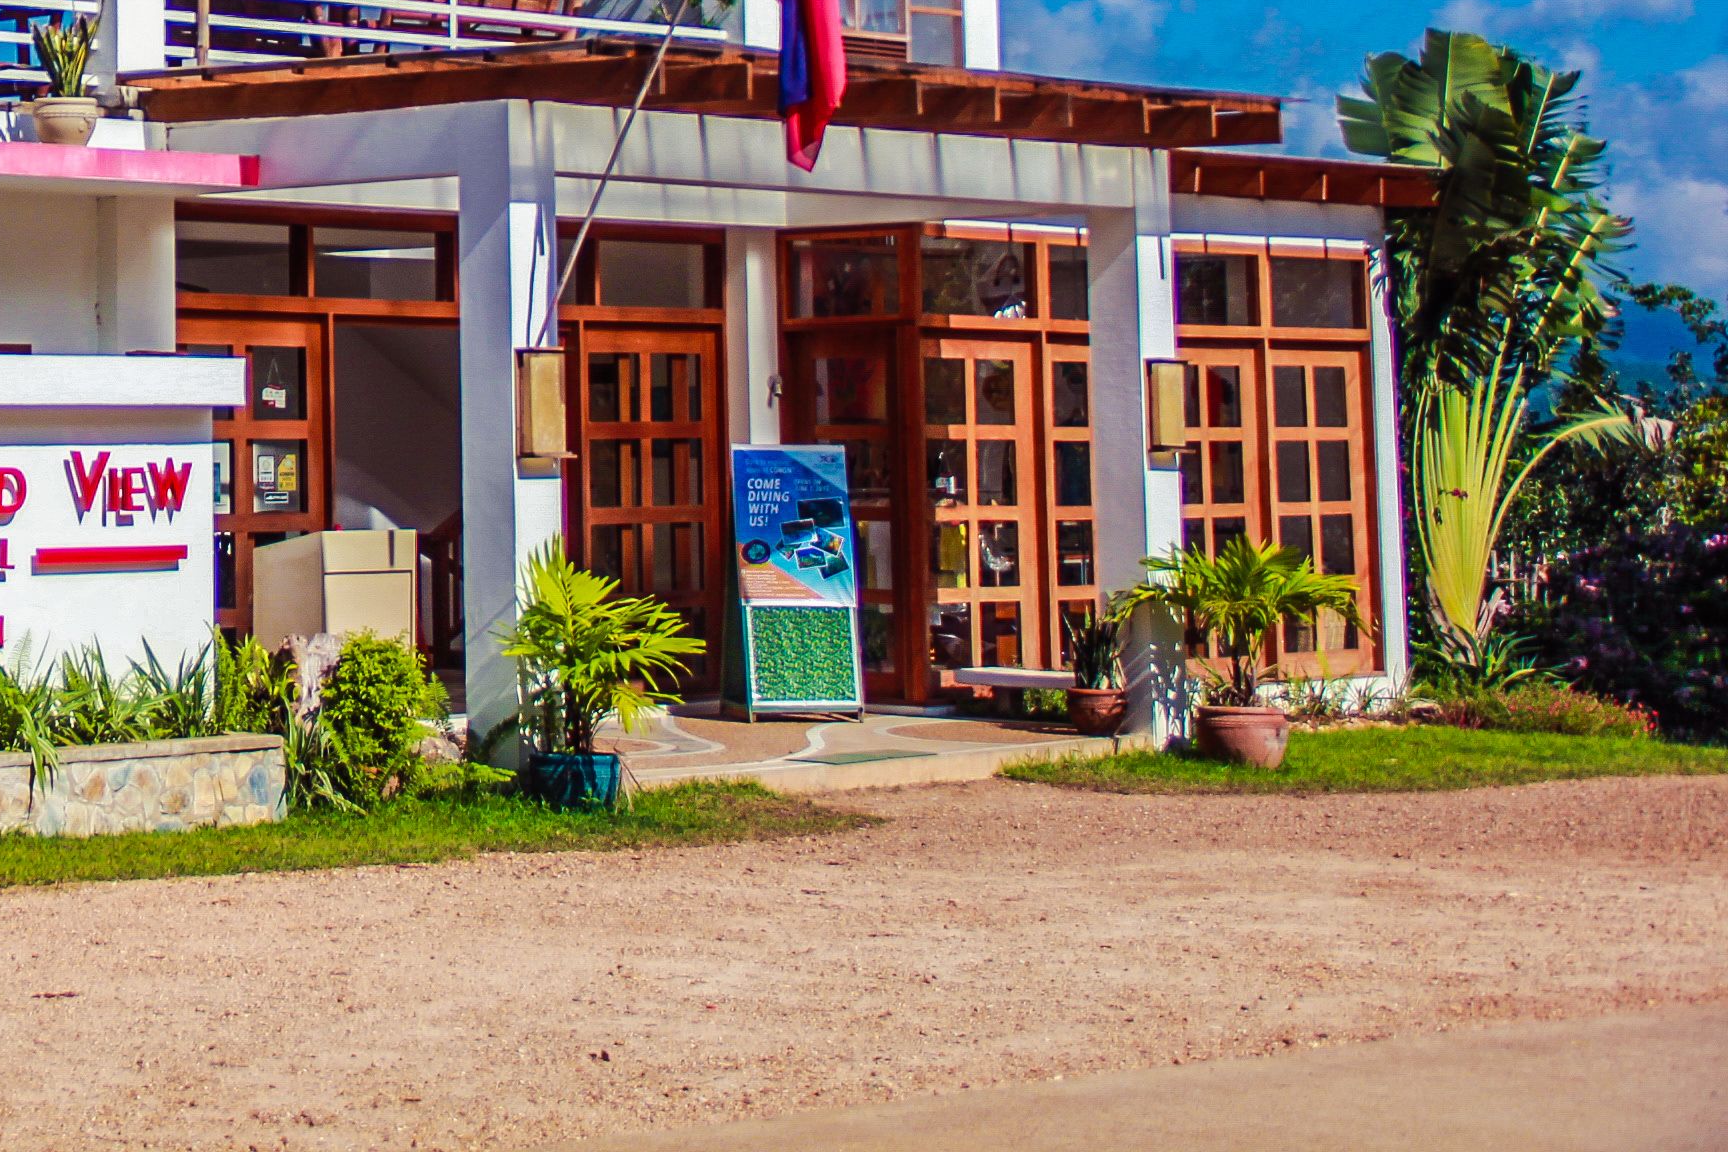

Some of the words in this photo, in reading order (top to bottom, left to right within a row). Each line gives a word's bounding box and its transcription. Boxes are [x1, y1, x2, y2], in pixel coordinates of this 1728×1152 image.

[68, 450, 193, 515] VIEW
[747, 478, 781, 490] COME
[748, 490, 790, 503] DIVING
[749, 503, 779, 514] WITH
[749, 515, 769, 527] US!
